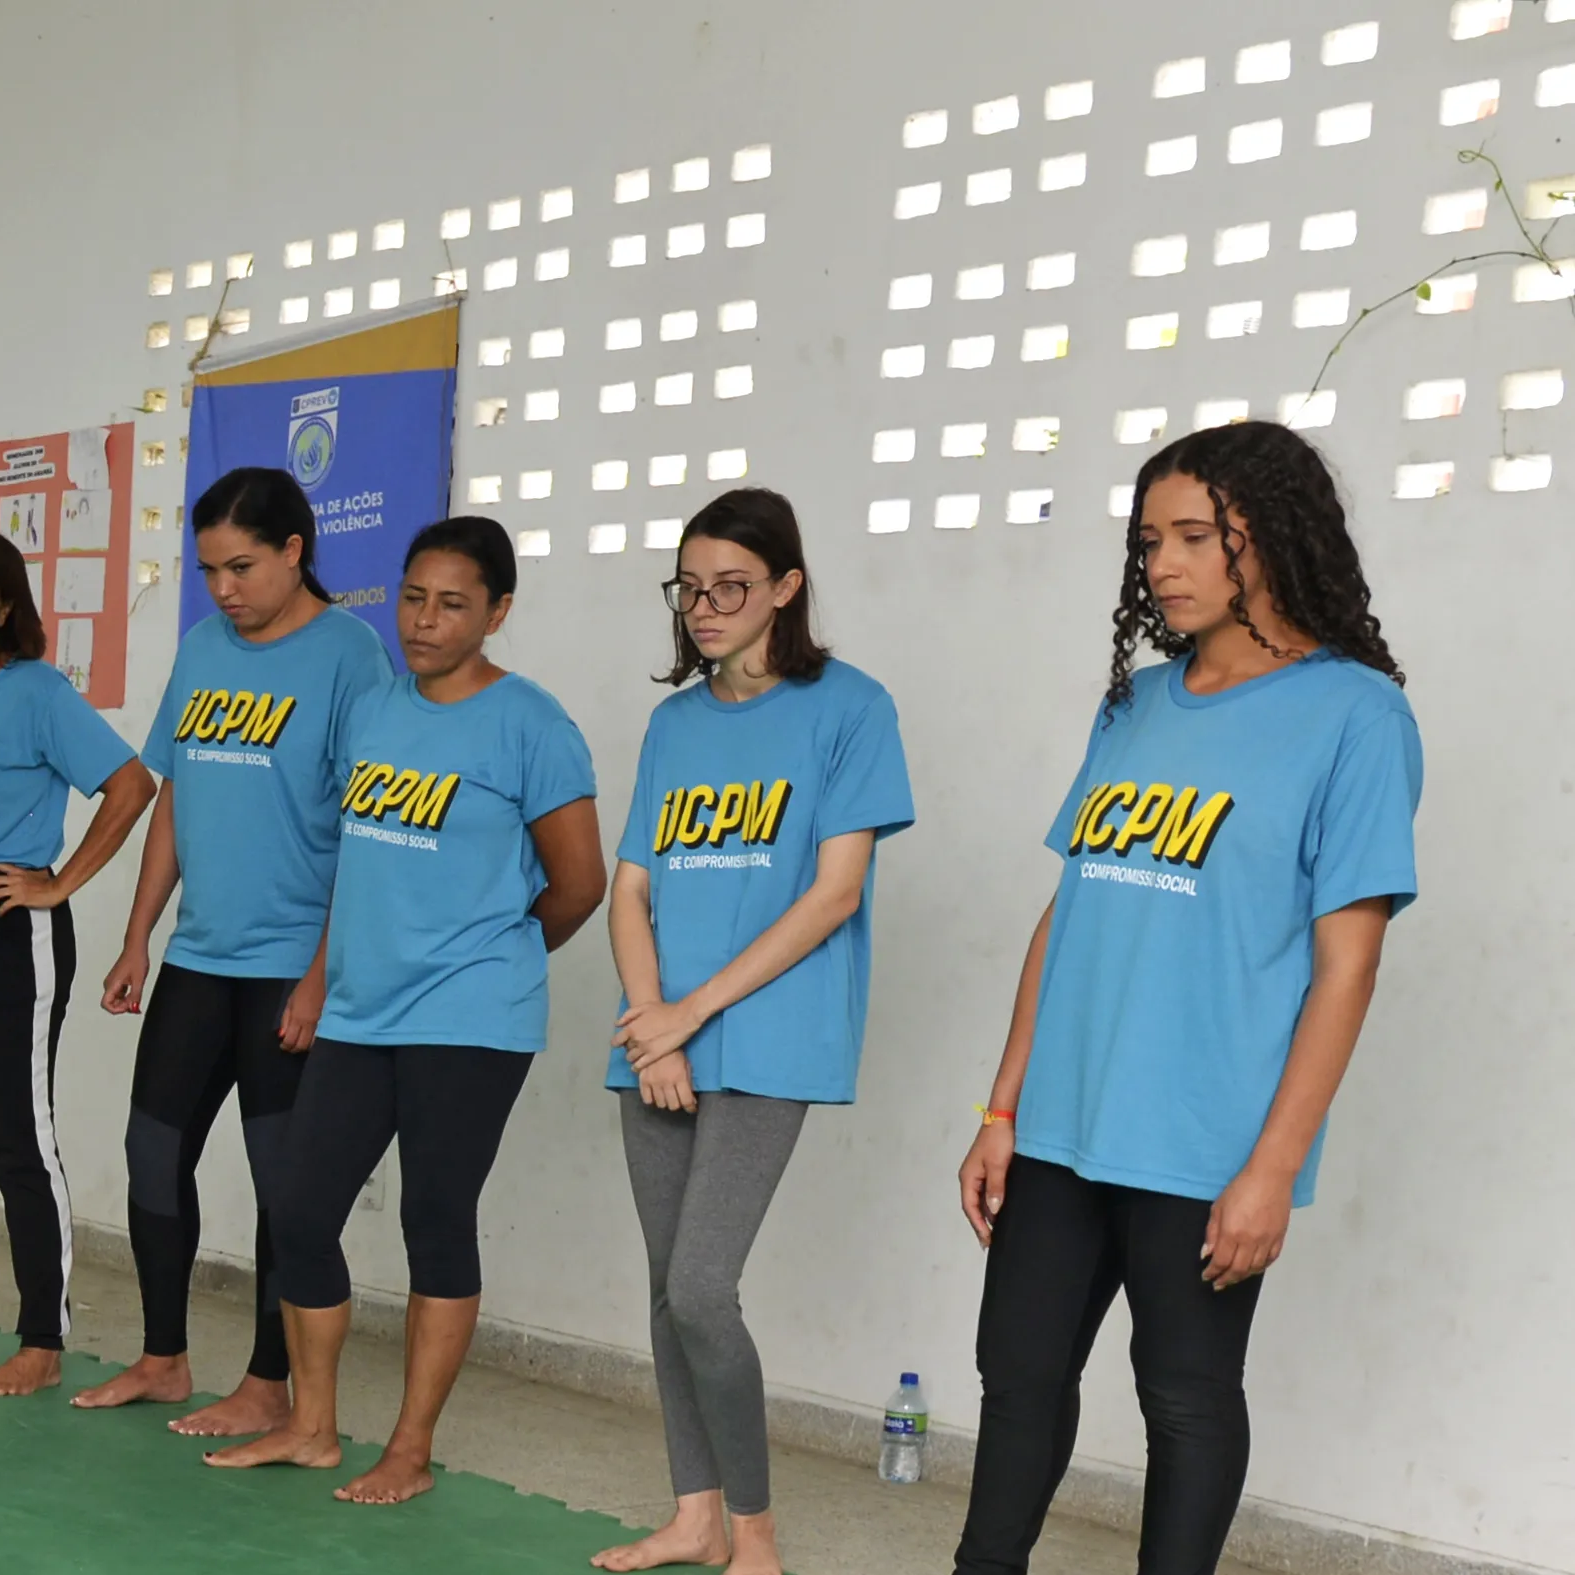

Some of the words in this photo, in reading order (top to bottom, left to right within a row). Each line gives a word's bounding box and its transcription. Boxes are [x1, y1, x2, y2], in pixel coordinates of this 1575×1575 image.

[327, 499, 341, 514] DE
[343, 491, 384, 513] AÇÕES
[322, 512, 384, 536] VIOLÊNCIA
[245, 752, 272, 767] SOCIAL
[353, 823, 408, 846] COMPROMISSO
[408, 834, 439, 851] SOCIAL
[668, 856, 682, 870] DE
[1154, 871, 1198, 896] SOCIAL
